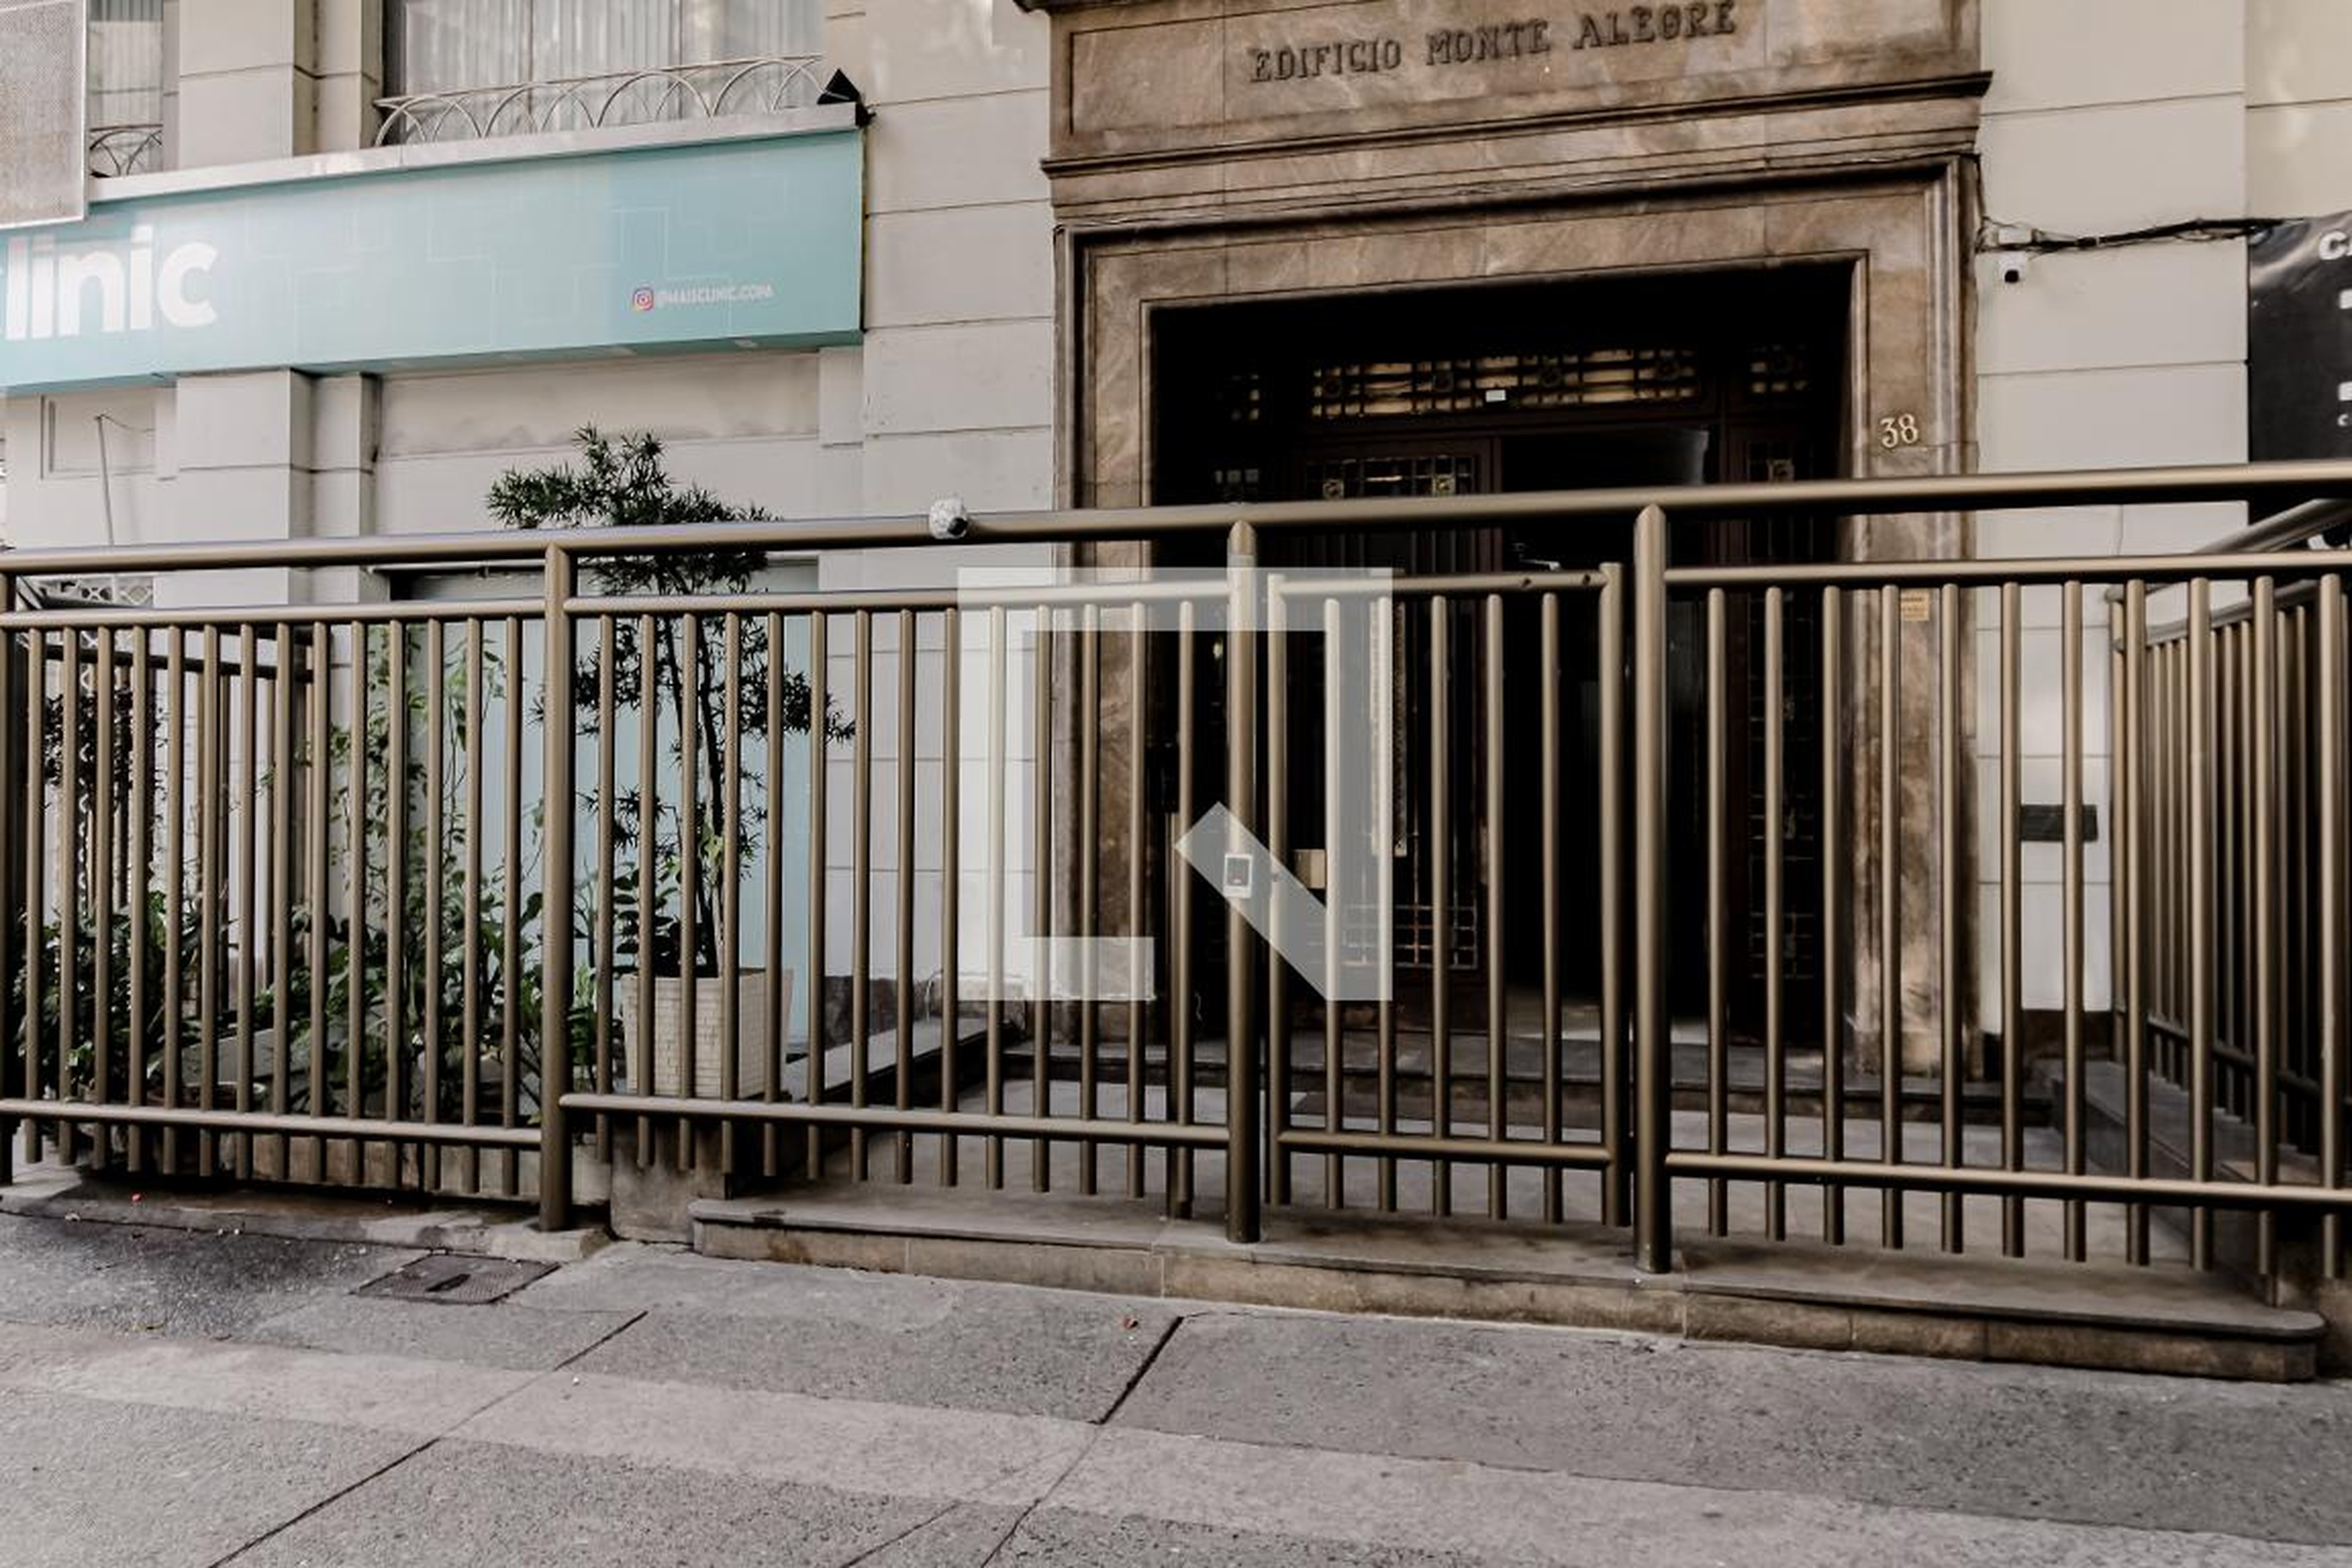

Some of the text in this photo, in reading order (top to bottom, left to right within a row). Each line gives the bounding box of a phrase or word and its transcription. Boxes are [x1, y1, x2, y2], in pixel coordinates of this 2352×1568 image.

[1248, 0, 1736, 83] EDIFICIO MONTE ALEGRE
[1880, 413, 1918, 448] 38
